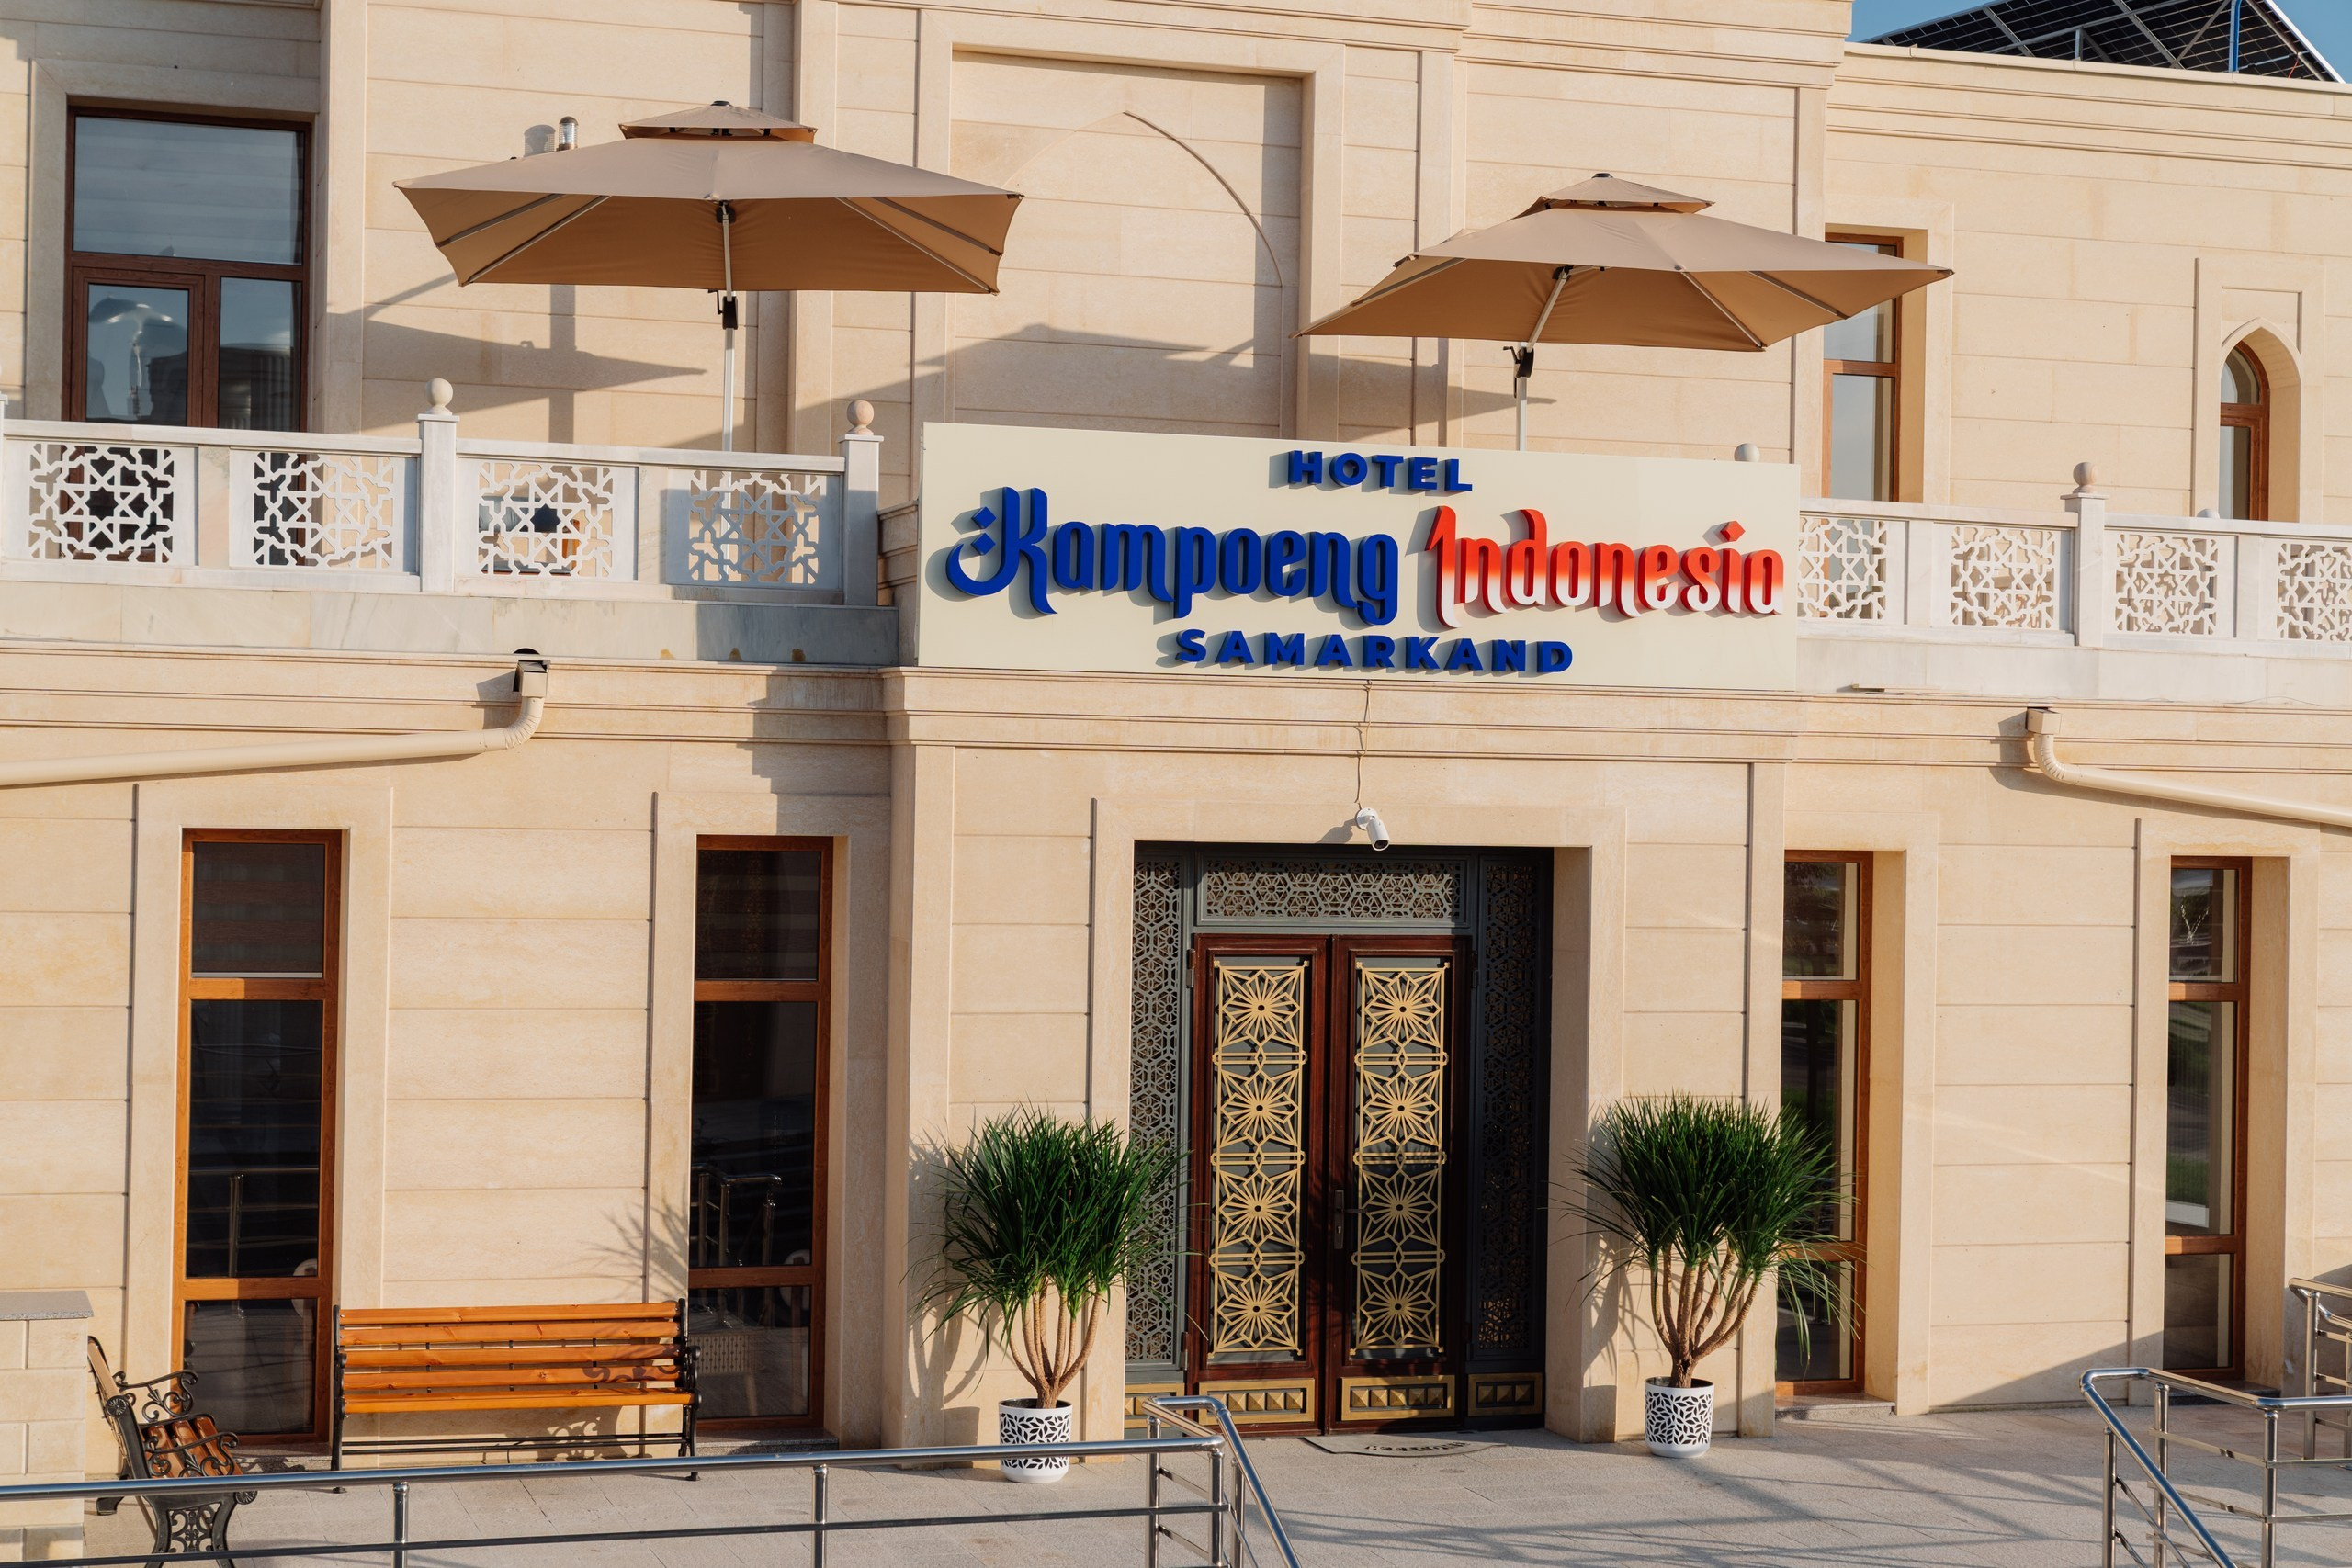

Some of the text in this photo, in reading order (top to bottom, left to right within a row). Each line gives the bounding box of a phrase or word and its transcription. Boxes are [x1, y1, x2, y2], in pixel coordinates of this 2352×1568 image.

[1288, 450, 1473, 491] HOTEL
[946, 487, 1783, 629] Kampoeng Indonesia
[1175, 629, 1573, 674] SAMARKAND
